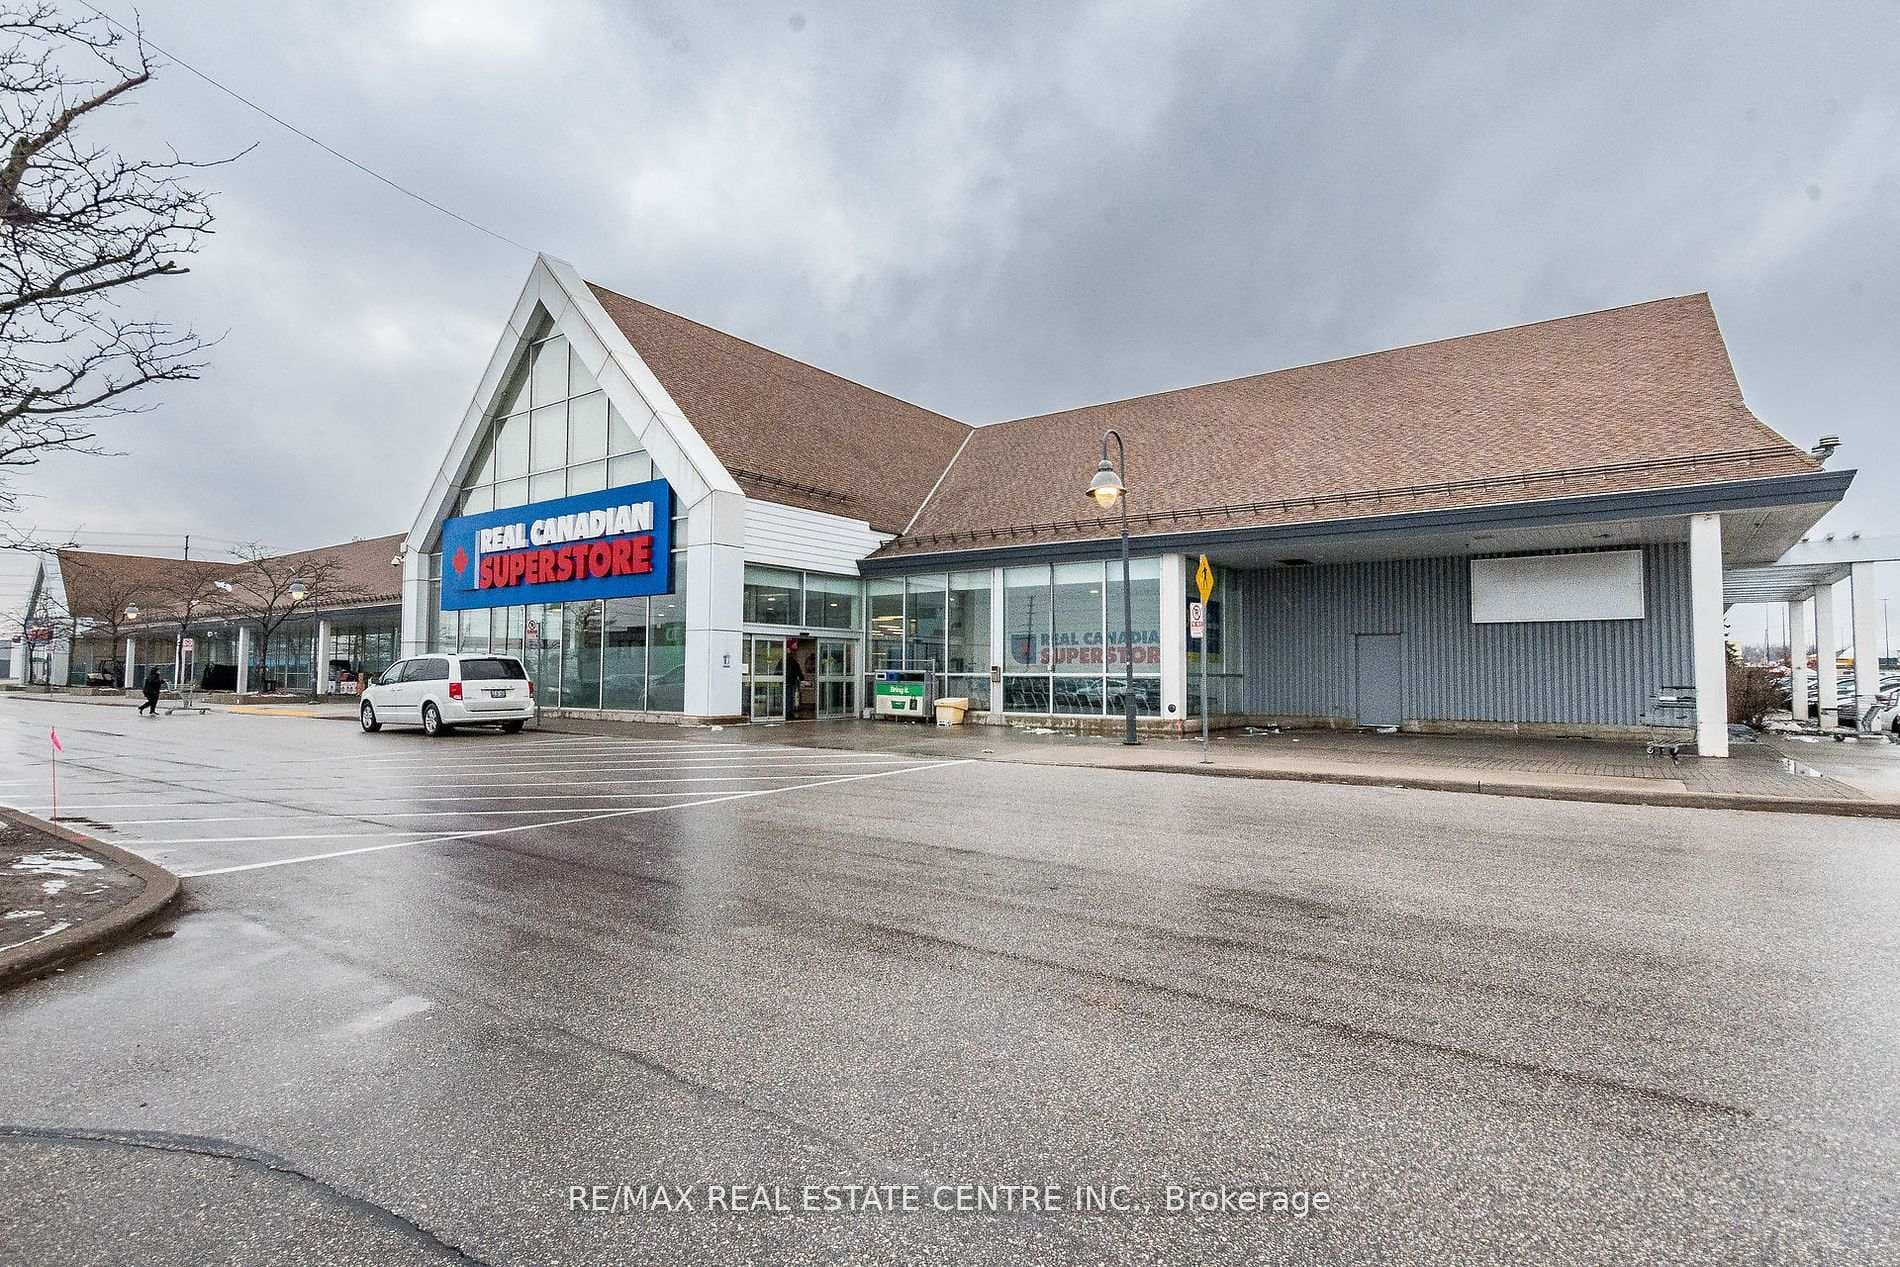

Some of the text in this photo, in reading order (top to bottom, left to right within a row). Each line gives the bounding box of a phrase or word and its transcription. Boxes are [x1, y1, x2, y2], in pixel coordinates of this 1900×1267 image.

[480, 501, 654, 554] REAL CANADIAN
[480, 536, 653, 589] SUPERSTORE
[1040, 632, 1079, 646] REAL
